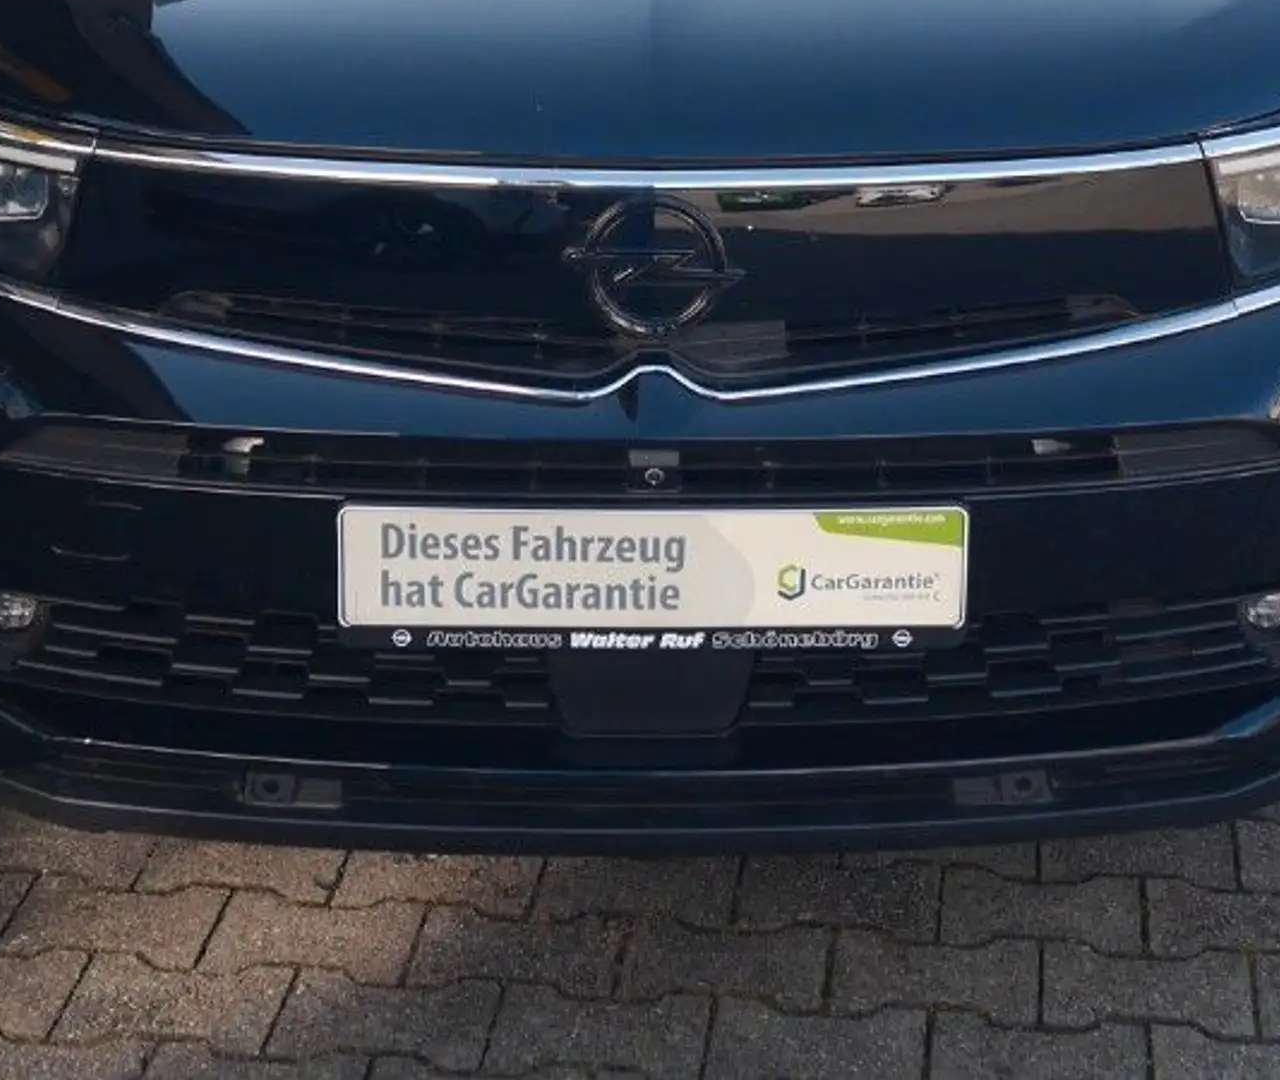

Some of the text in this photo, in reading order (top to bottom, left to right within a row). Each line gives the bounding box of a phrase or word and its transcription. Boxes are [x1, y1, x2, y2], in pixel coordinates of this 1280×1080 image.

[380, 523, 686, 573] Dieses Fahrzeug
[380, 569, 680, 611] hat CarGarantie
[426, 630, 563, 649] Autohaus
[570, 631, 656, 650] Walter
[659, 631, 707, 650] Ruf
